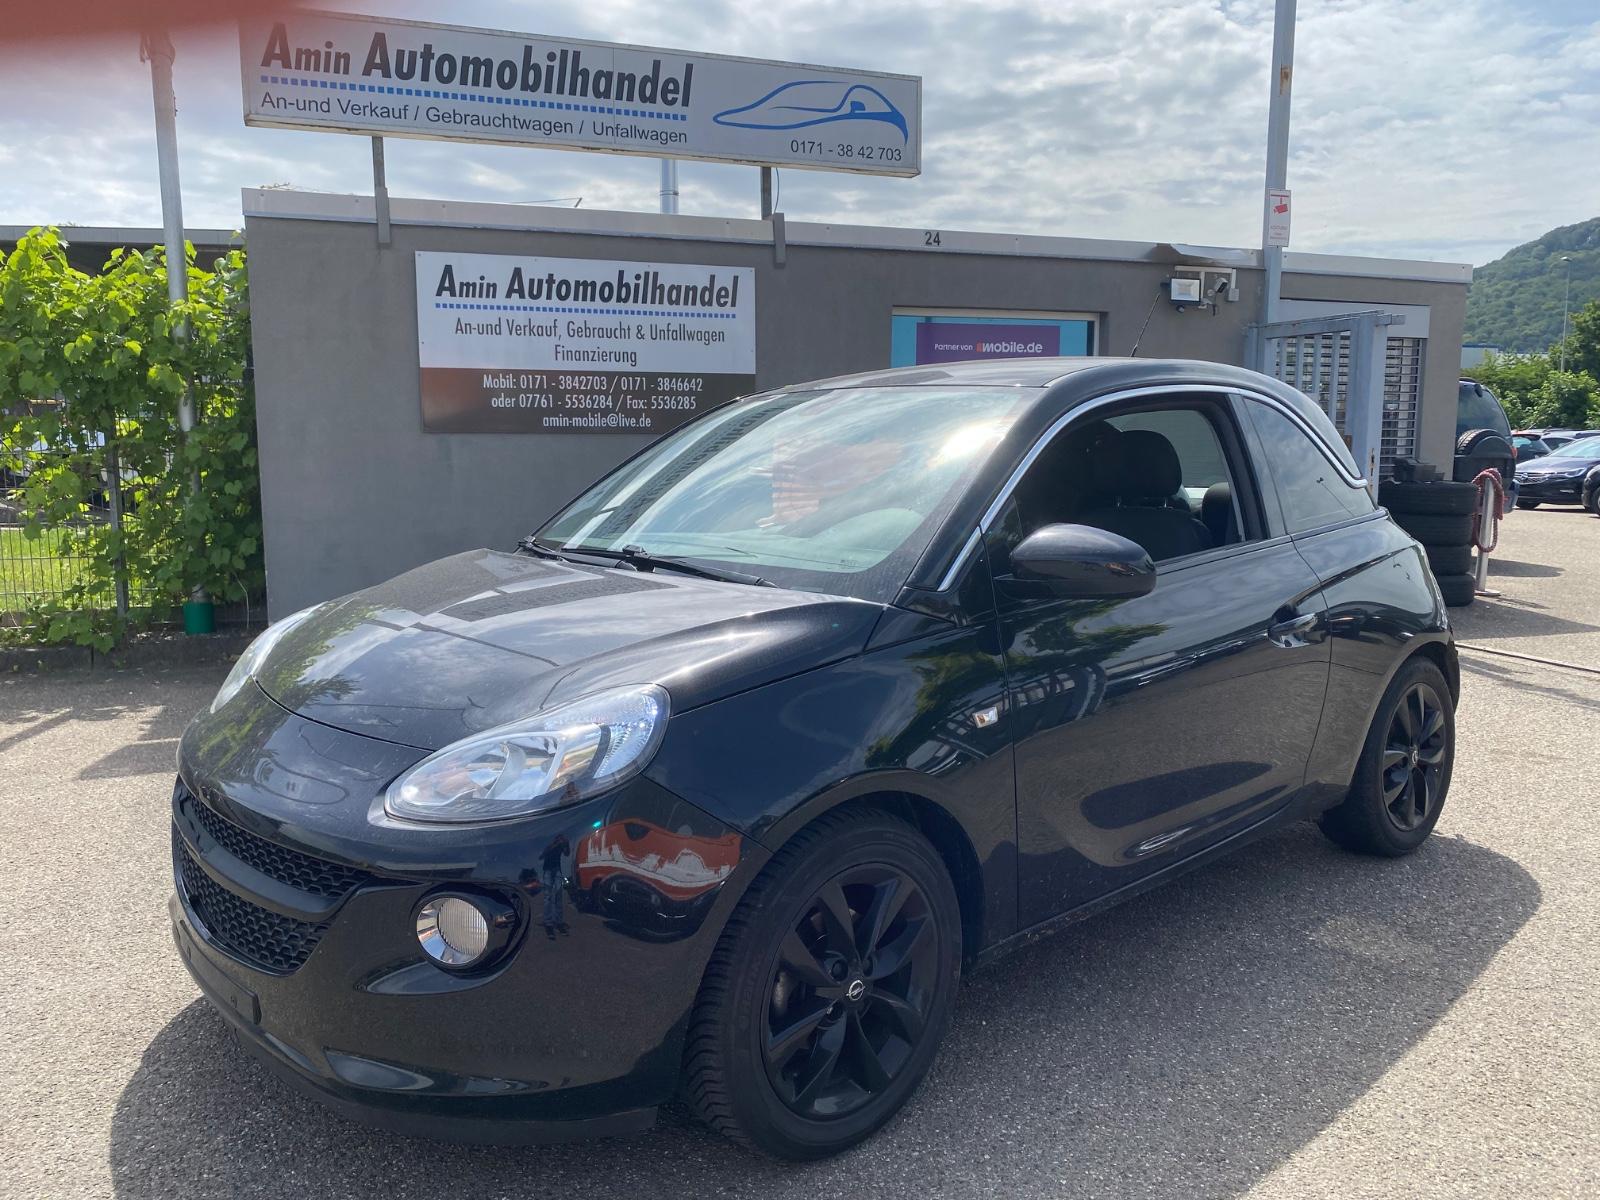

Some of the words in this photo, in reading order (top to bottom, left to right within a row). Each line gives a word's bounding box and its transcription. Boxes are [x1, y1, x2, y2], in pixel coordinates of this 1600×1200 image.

[260, 22, 350, 75] Amin
[362, 32, 694, 107] Automobilhandel
[261, 92, 331, 113] An-und
[337, 98, 410, 120] Verkauf
[426, 106, 574, 136] Gebrauchtwagen
[593, 120, 688, 145] Unfallwagen
[790, 139, 823, 155] 0171
[837, 144, 854, 158] 38
[857, 145, 874, 160] 42
[878, 146, 902, 162] 703
[924, 231, 942, 247] 24
[435, 264, 498, 299] Amin
[505, 266, 739, 308] Automobilhandel
[455, 317, 502, 335] An-und
[506, 318, 562, 341] Verkauf,
[567, 320, 631, 340] Gebraucht
[636, 324, 645, 340] &
[650, 322, 725, 345] Unfallwagen
[554, 344, 637, 367] Finanzierung
[934, 343, 960, 352] Partner
[981, 341, 1043, 353] mobile.de
[483, 374, 517, 389] Mobil:
[520, 375, 547, 390] 0171
[559, 375, 607, 391] 3842703
[621, 377, 646, 391] 0171
[657, 378, 703, 392] 3846642
[491, 393, 516, 408] oder
[519, 394, 553, 408] 07761
[565, 394, 613, 409] 5536284
[626, 396, 647, 409] Fax:
[651, 396, 696, 410] 5536285
[543, 412, 651, 428] amin-mobile@live.de
